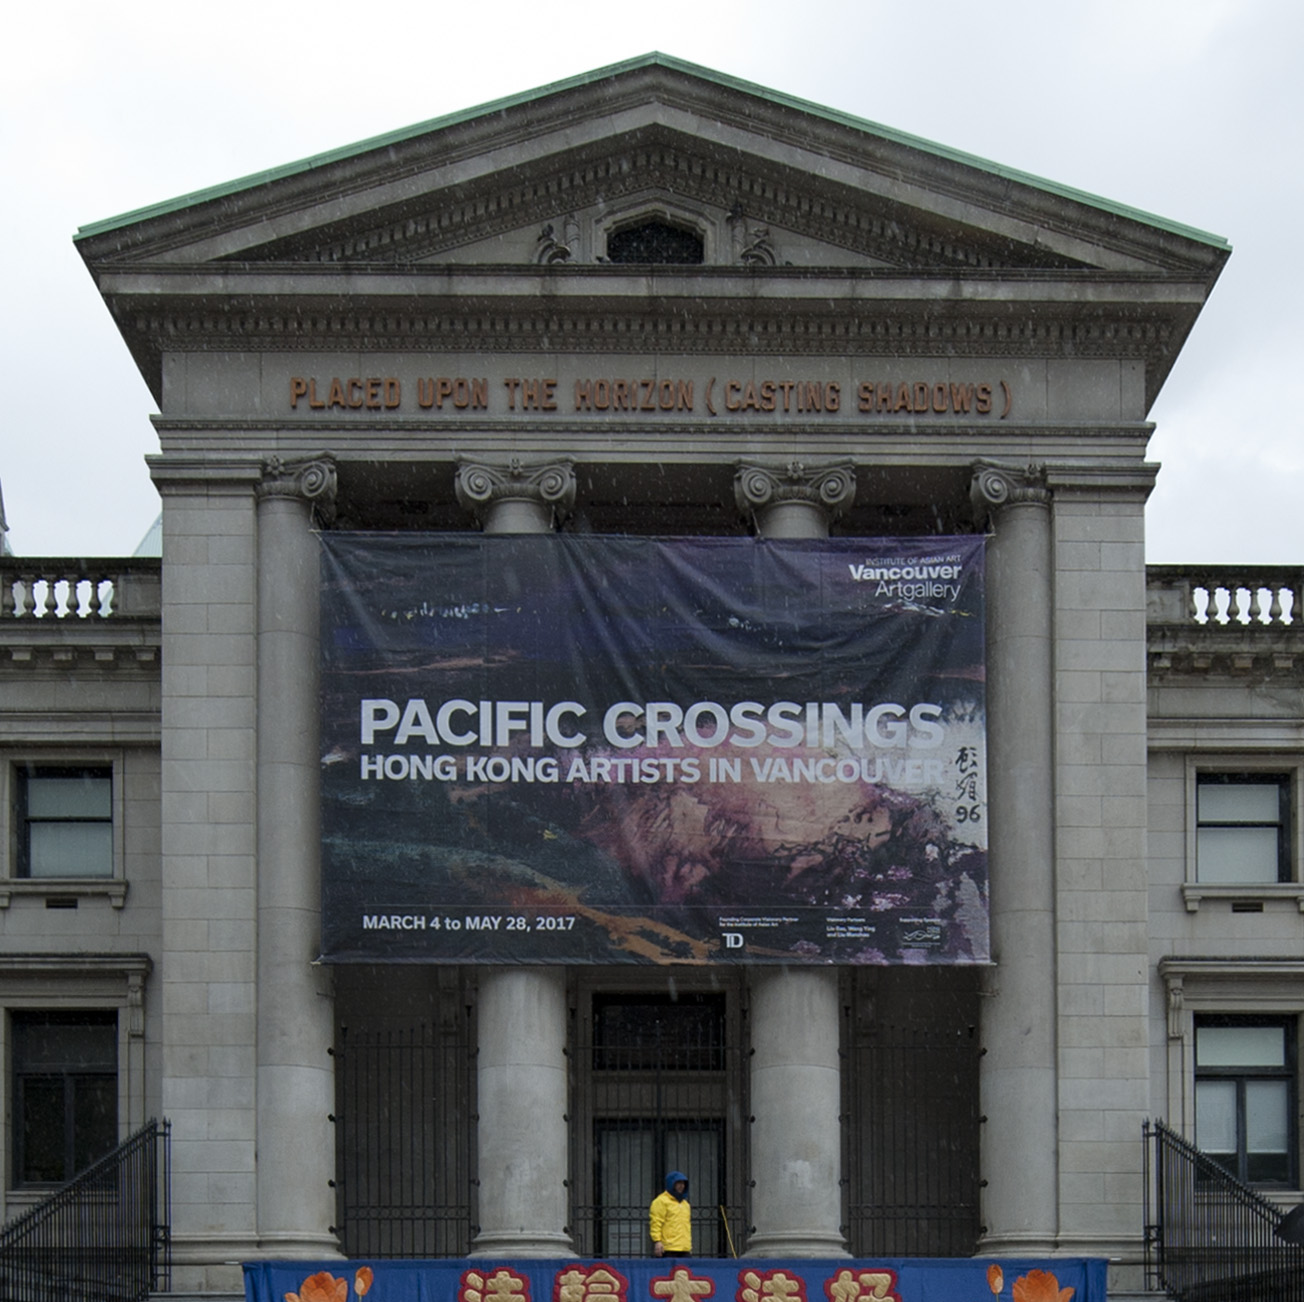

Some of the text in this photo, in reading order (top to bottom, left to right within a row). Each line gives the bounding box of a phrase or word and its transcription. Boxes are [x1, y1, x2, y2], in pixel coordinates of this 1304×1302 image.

[290, 377, 401, 409] PLACED
[417, 377, 489, 410] UPON
[503, 378, 558, 411] THE
[575, 378, 694, 412] HORIZON
[848, 564, 962, 580] Vancouver
[874, 580, 962, 602] Artgallery
[361, 698, 945, 750] PACIFIC CROSSINGS
[360, 753, 946, 785] HONG KONG ARTISTS IN VANCOUVER
[956, 803, 982, 824] 96
[362, 914, 576, 933] MARCH 4 to MAY 28, 2017
[721, 932, 744, 948] TD
